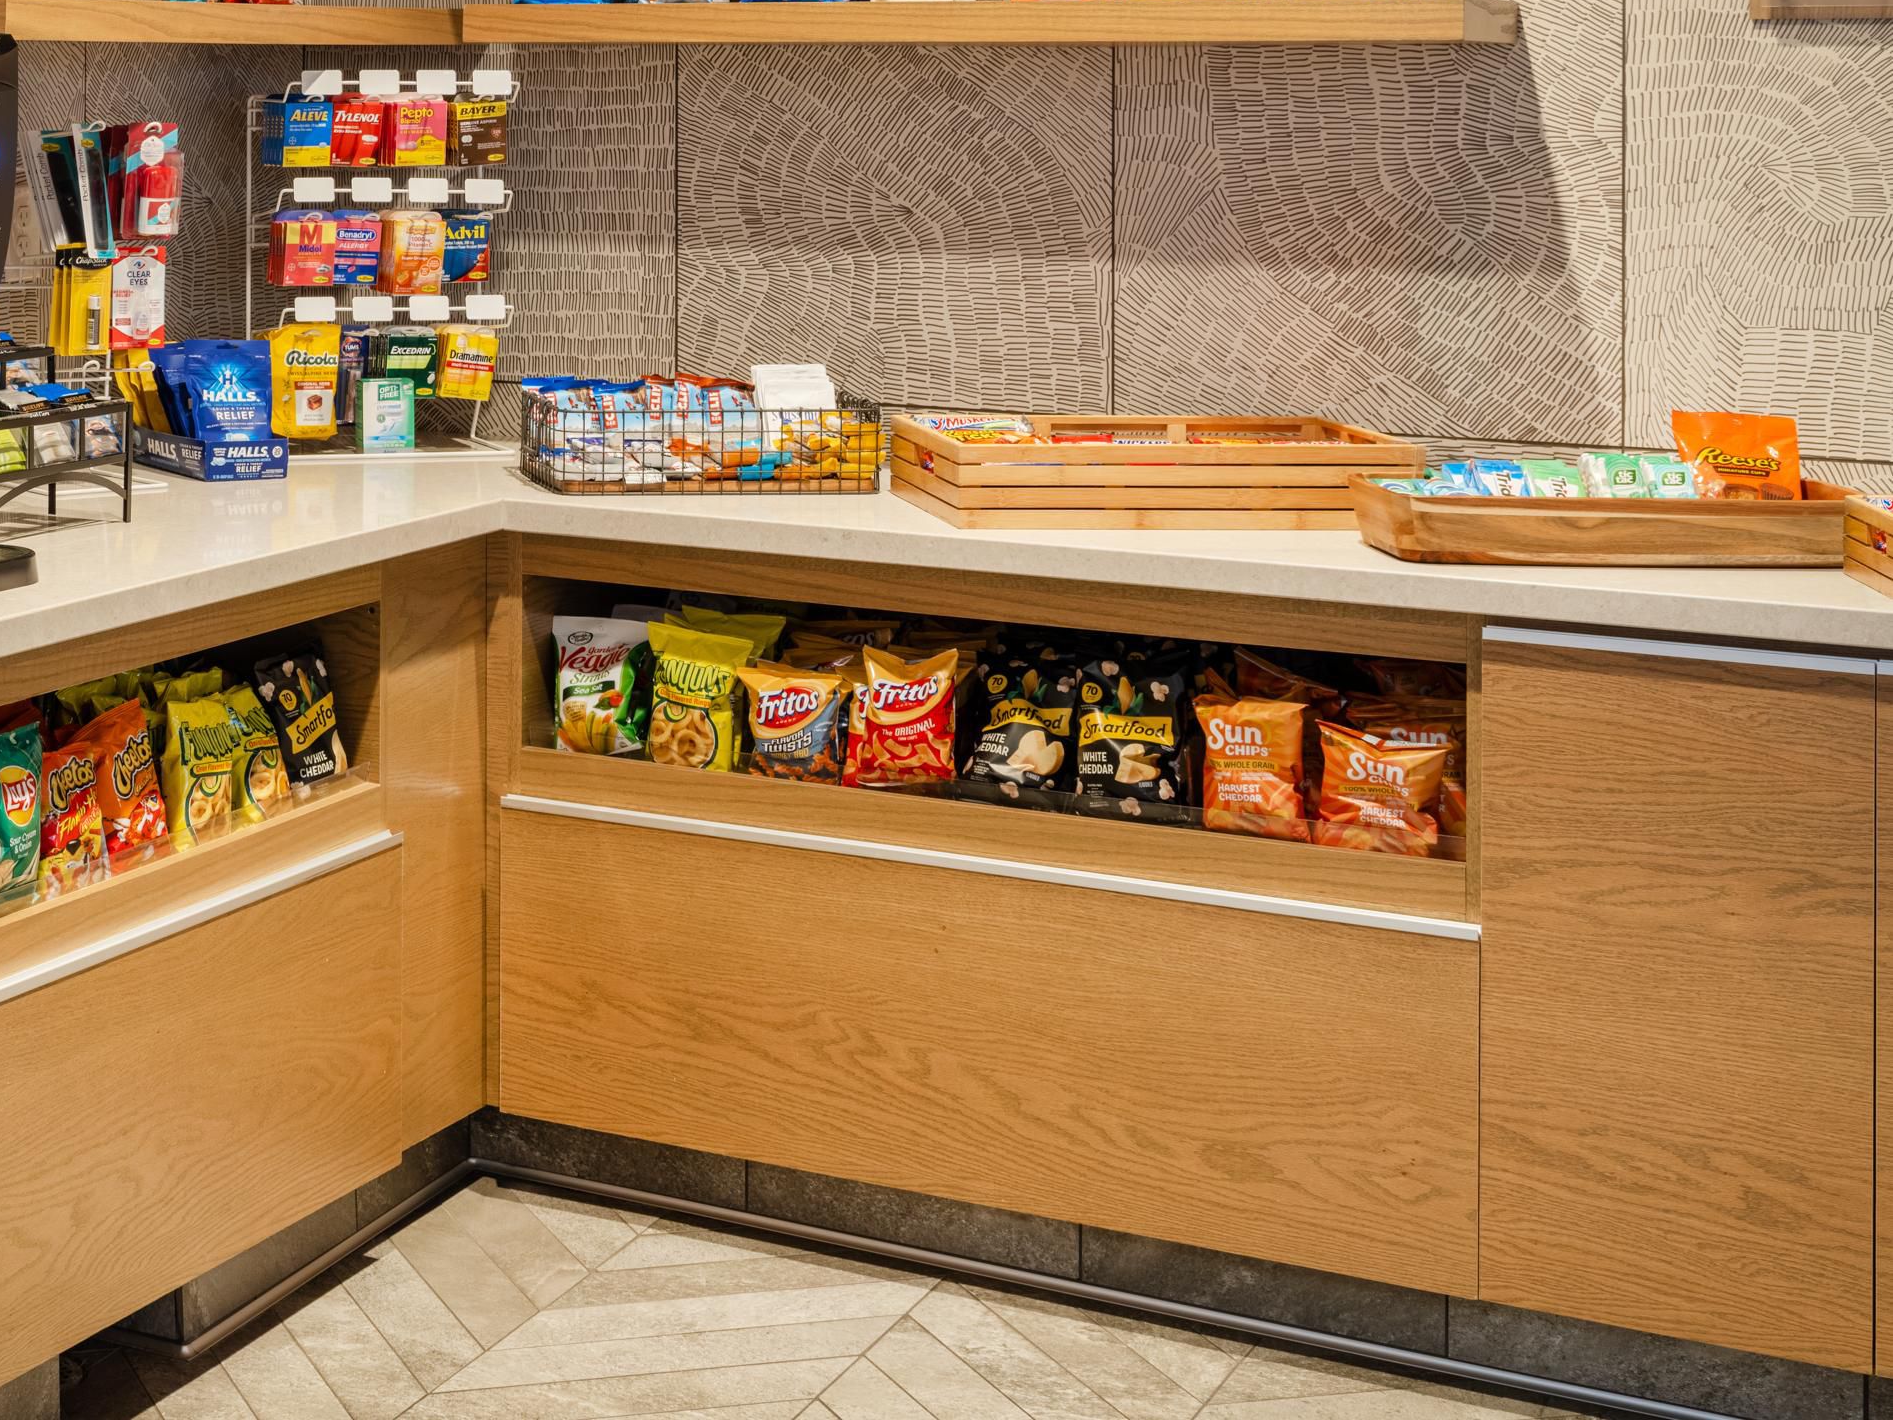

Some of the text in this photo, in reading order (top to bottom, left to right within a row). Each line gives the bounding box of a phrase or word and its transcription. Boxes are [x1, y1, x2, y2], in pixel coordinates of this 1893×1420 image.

[290, 110, 328, 122] ALEVE
[400, 107, 434, 120] Pepto
[460, 105, 496, 115] BAYER
[334, 111, 379, 123] TYLENOL
[338, 230, 373, 240] Benadryl
[444, 225, 485, 240] Advil
[75, 256, 107, 265] ChapStick
[127, 270, 151, 278] CLEAR
[129, 278, 148, 286] EYES
[390, 346, 432, 355] EXCEDRIN
[449, 349, 493, 364] Dramamine
[286, 350, 337, 366] Ricola
[379, 392, 399, 400] FREE
[216, 411, 255, 420] RELIEF
[181, 448, 202, 461] RELIEF
[1695, 447, 1780, 471] Reese's
[1618, 470, 1634, 478] tic
[559, 644, 630, 673] Veggie
[873, 677, 939, 710] Fritos
[756, 687, 819, 723] Fritos
[990, 705, 1066, 730] Smartfood
[894, 719, 935, 736] ORIGINAL
[1082, 717, 1167, 740] Smartfood
[772, 731, 804, 744] FLAVOR
[1208, 718, 1263, 751] Sun
[303, 751, 328, 764] WHITE
[1225, 745, 1269, 757] CHIPS
[1082, 752, 1108, 764] WHITE
[300, 760, 334, 778] CHEDDAR
[1079, 763, 1114, 775] CHEDDAR
[1346, 752, 1404, 785] Sun
[49, 756, 96, 811] Cheetos
[1217, 783, 1260, 793] HARVEST
[4, 773, 37, 811] Lay's
[1218, 793, 1263, 803] CHEDDAR
